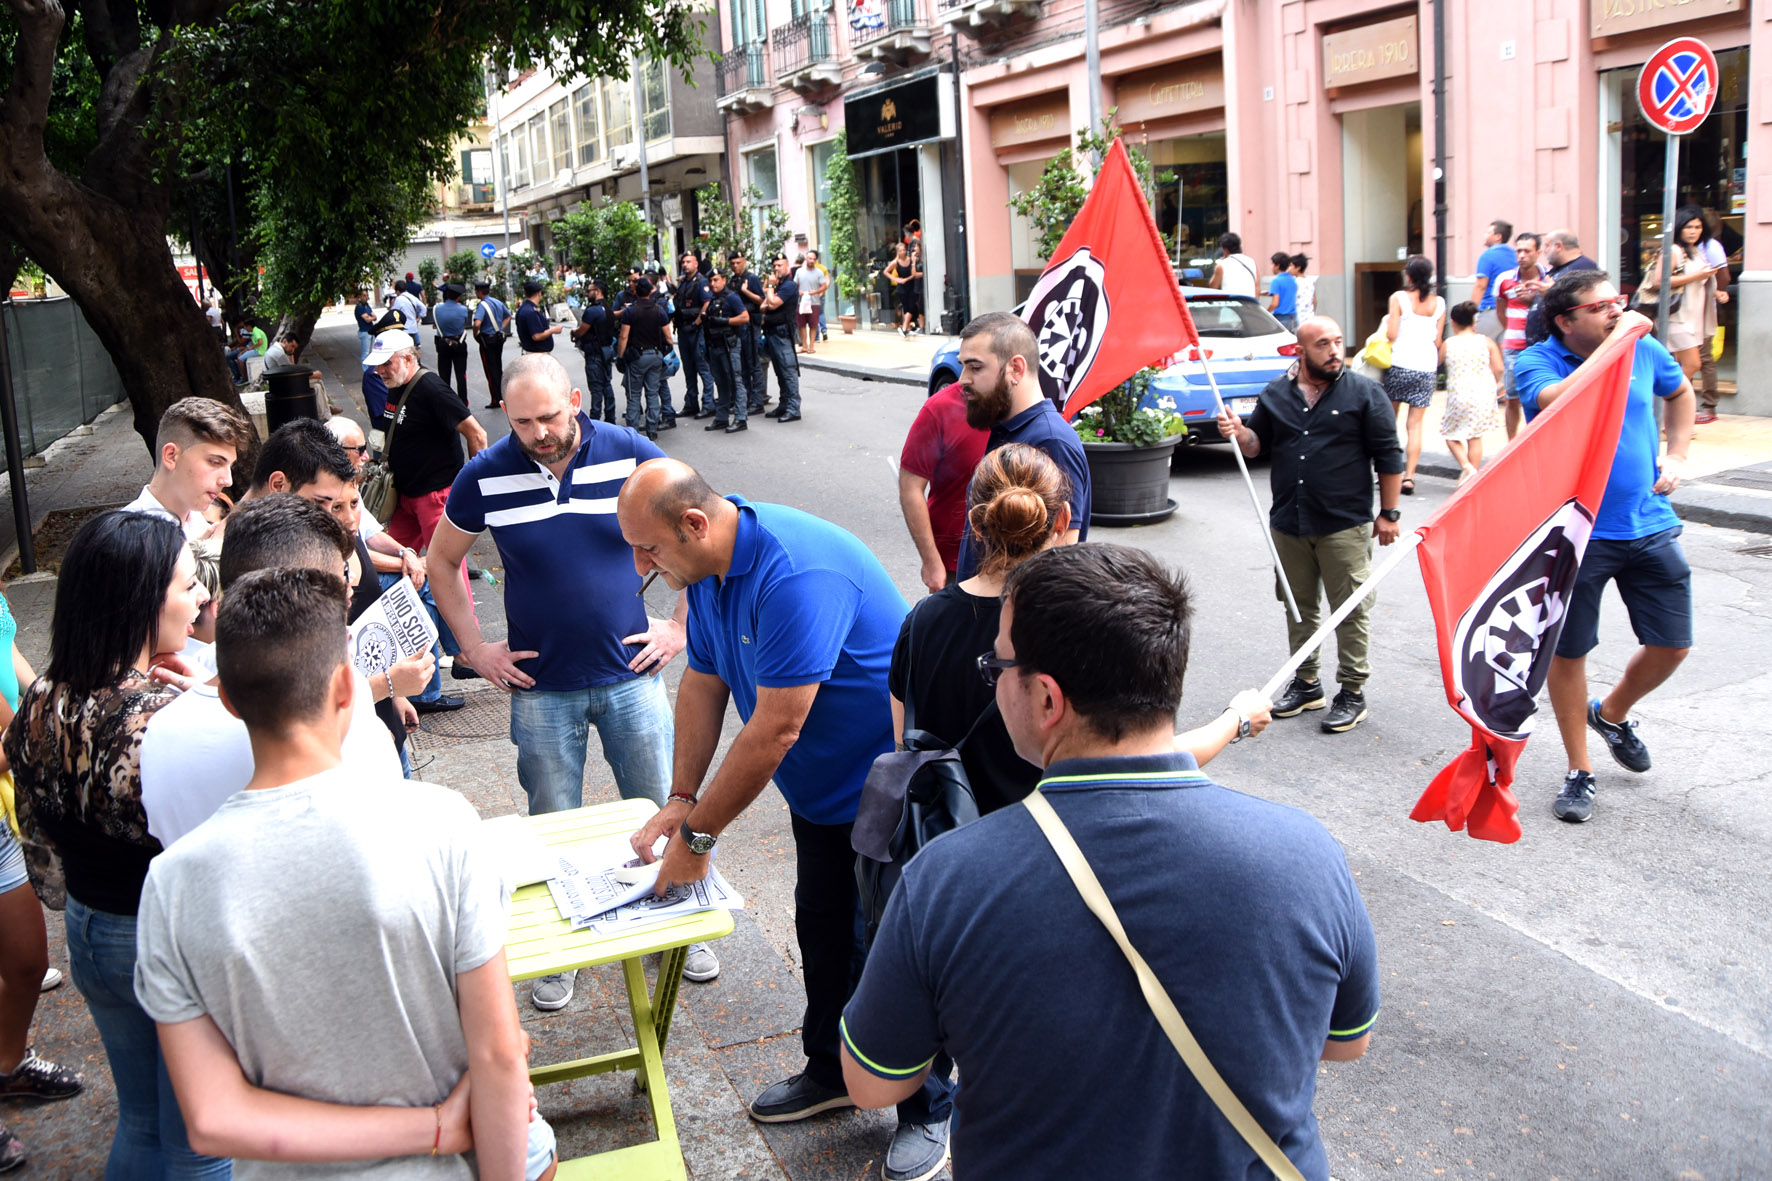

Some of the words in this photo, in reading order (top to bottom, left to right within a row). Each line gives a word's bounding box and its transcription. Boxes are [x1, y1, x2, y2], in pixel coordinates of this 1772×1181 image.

[1330, 48, 1376, 75] IRRERA
[1378, 40, 1409, 65] 1910
[877, 121, 902, 134] VALERIO
[389, 586, 412, 618] UNO
[392, 622, 406, 645] DELLA
